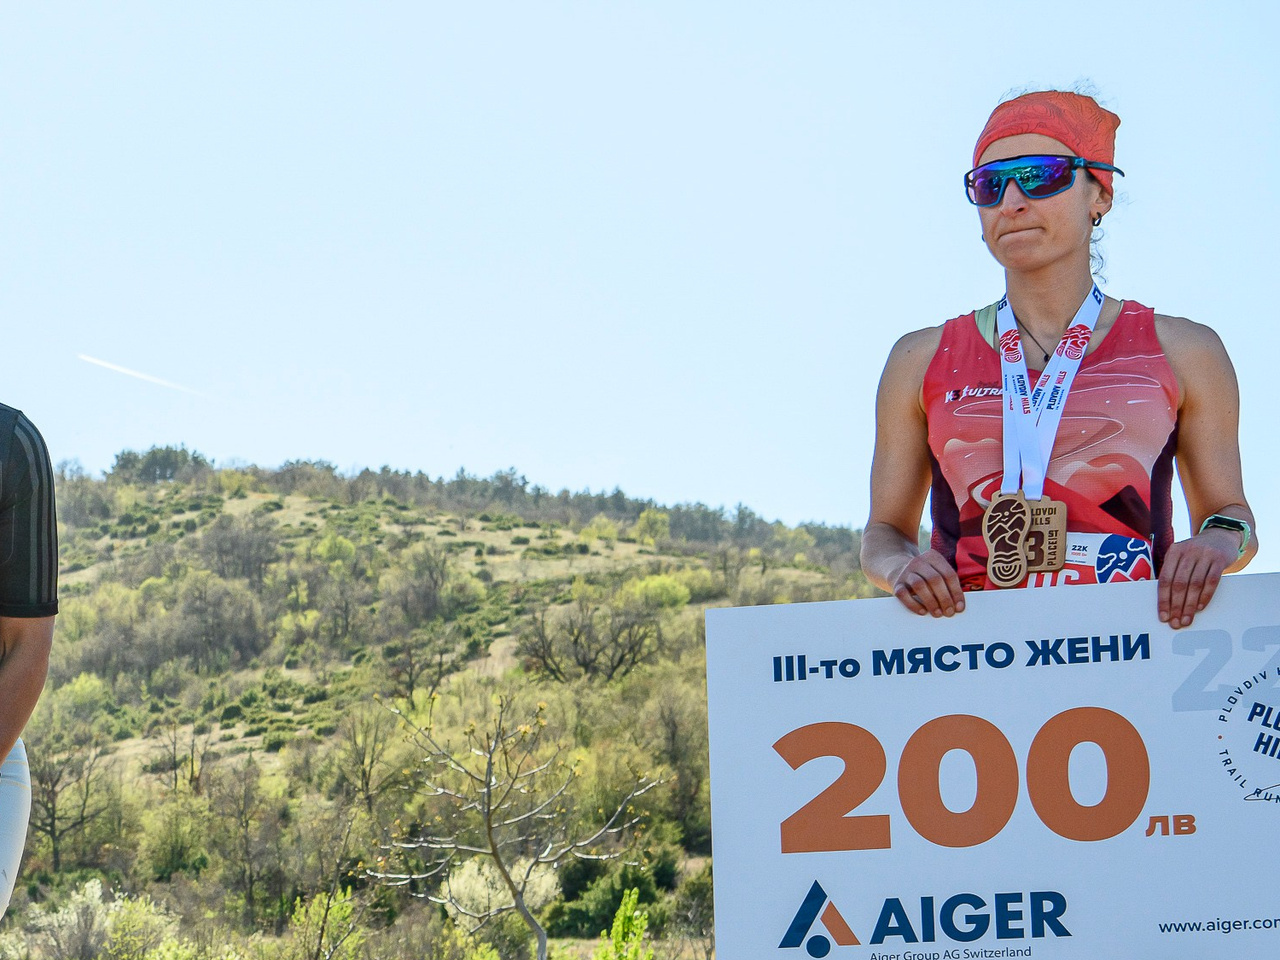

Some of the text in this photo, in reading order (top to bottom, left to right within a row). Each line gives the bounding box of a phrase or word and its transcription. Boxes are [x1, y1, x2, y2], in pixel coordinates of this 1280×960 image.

[1025, 530, 1045, 567] 3
[872, 641, 1016, 677] МЯСТО
[1025, 632, 1152, 667] ЖЕНИ
[771, 706, 1151, 854] 200
[1218, 748, 1248, 789] TRAIL
[1145, 813, 1197, 839] лв
[868, 890, 1073, 945] AIGER
[942, 947, 961, 960] AG
[962, 944, 1033, 959] Switzerland
